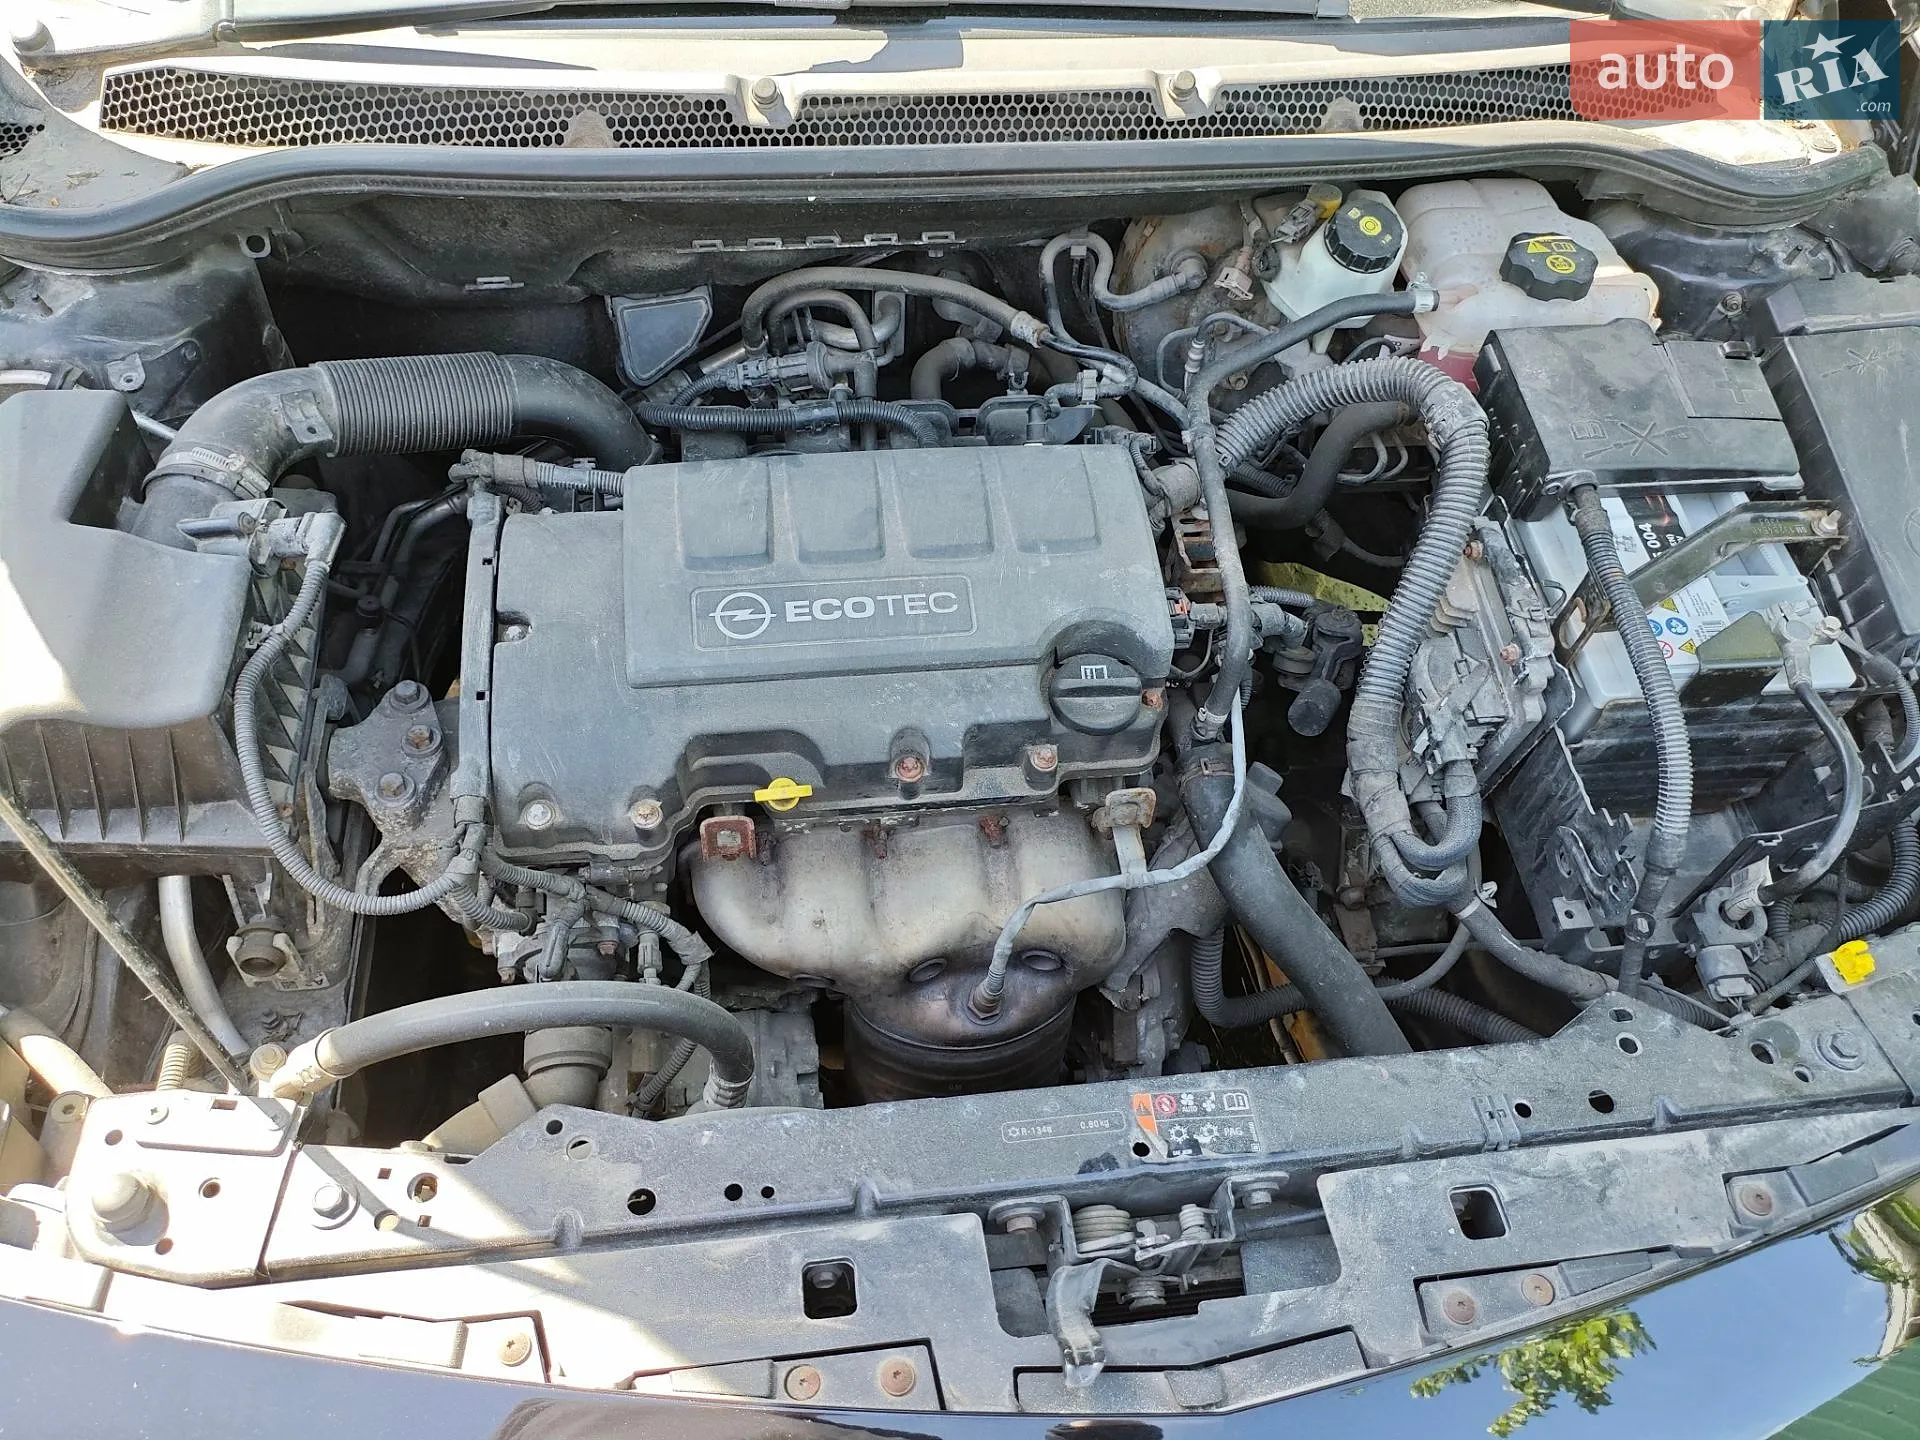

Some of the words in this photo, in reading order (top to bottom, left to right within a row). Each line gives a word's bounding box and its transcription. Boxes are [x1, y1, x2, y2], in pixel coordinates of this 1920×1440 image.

[784, 591, 959, 623] ECOTEC
[1181, 1105, 1198, 1113] AUTO
[1223, 1126, 1243, 1137] PAG
